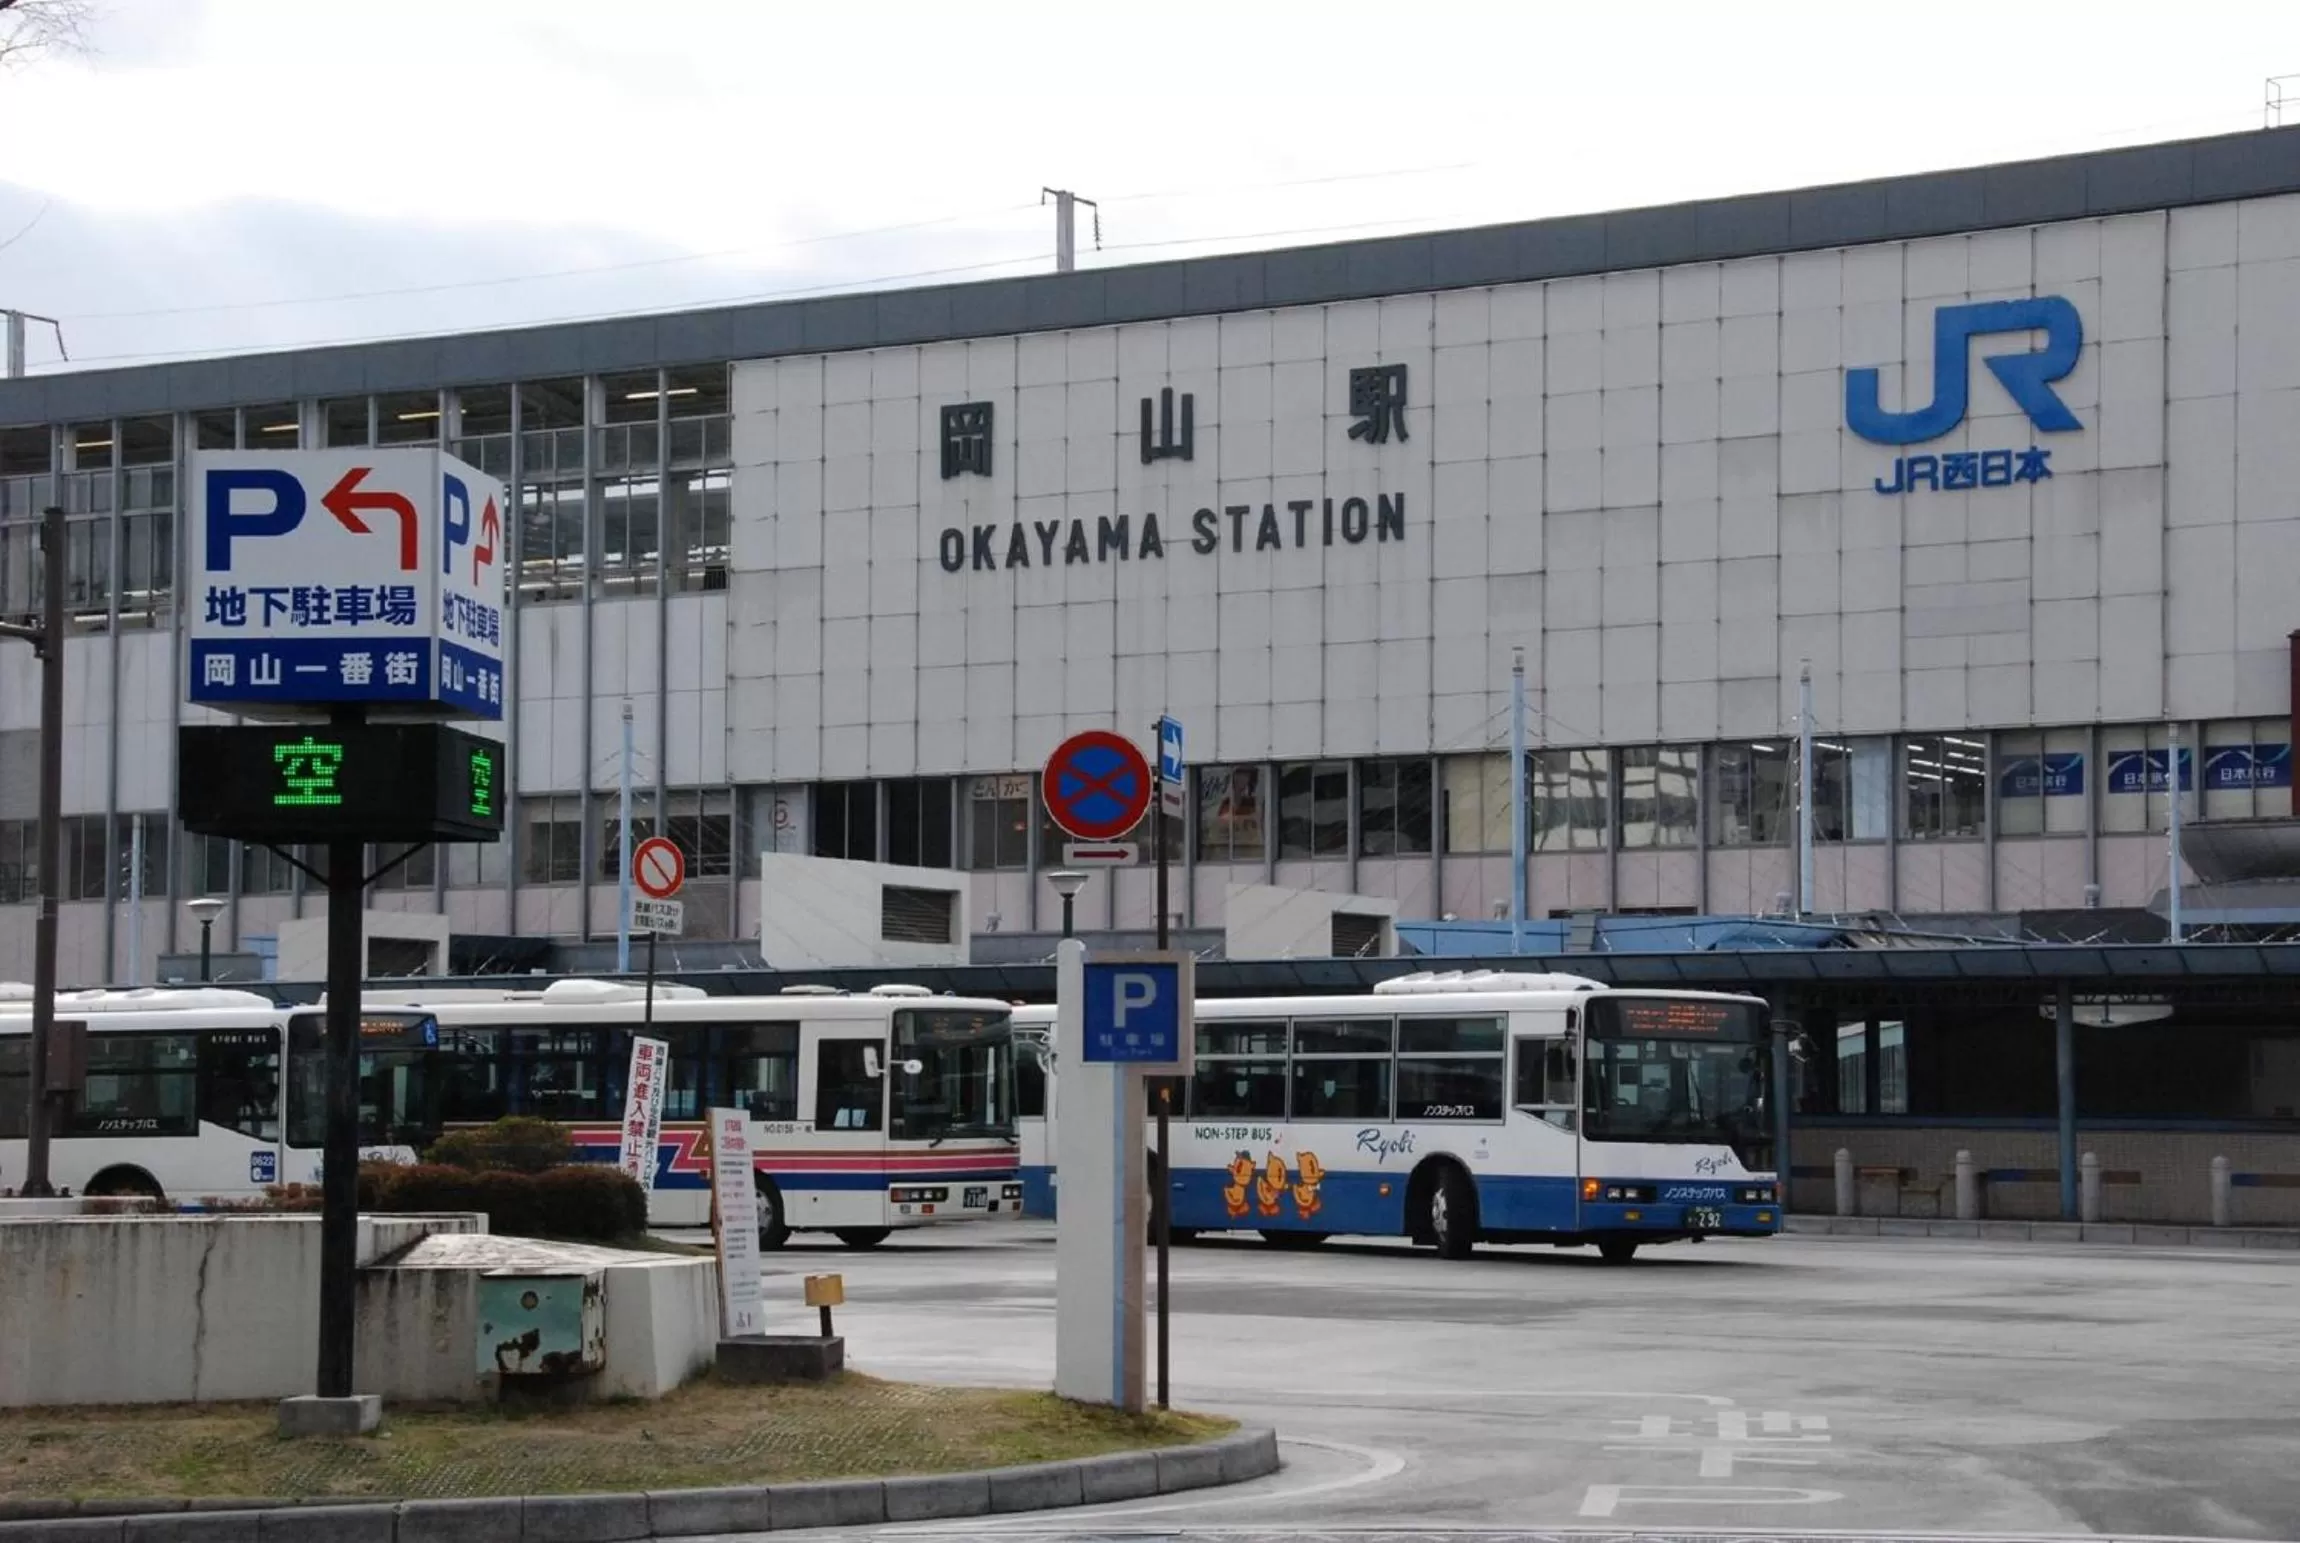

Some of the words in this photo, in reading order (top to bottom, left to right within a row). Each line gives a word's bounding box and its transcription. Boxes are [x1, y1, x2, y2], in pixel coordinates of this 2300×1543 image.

[1846, 295, 2084, 446] JR
[1875, 446, 2053, 494] JR西日本
[206, 469, 306, 571] P
[443, 472, 470, 575] P
[939, 512, 1164, 573] OKAYAMA
[1192, 492, 1405, 555] STATION
[205, 585, 417, 628] 地下駐車場
[443, 588, 499, 649] 地下駐車場
[203, 652, 419, 688] 岡山一番街
[274, 736, 343, 805] 空
[1113, 972, 1157, 1029] P
[1195, 1126, 1248, 1141] NON-STEP
[1251, 1127, 1272, 1141] BUS
[1356, 1128, 1416, 1164] Ryobi
